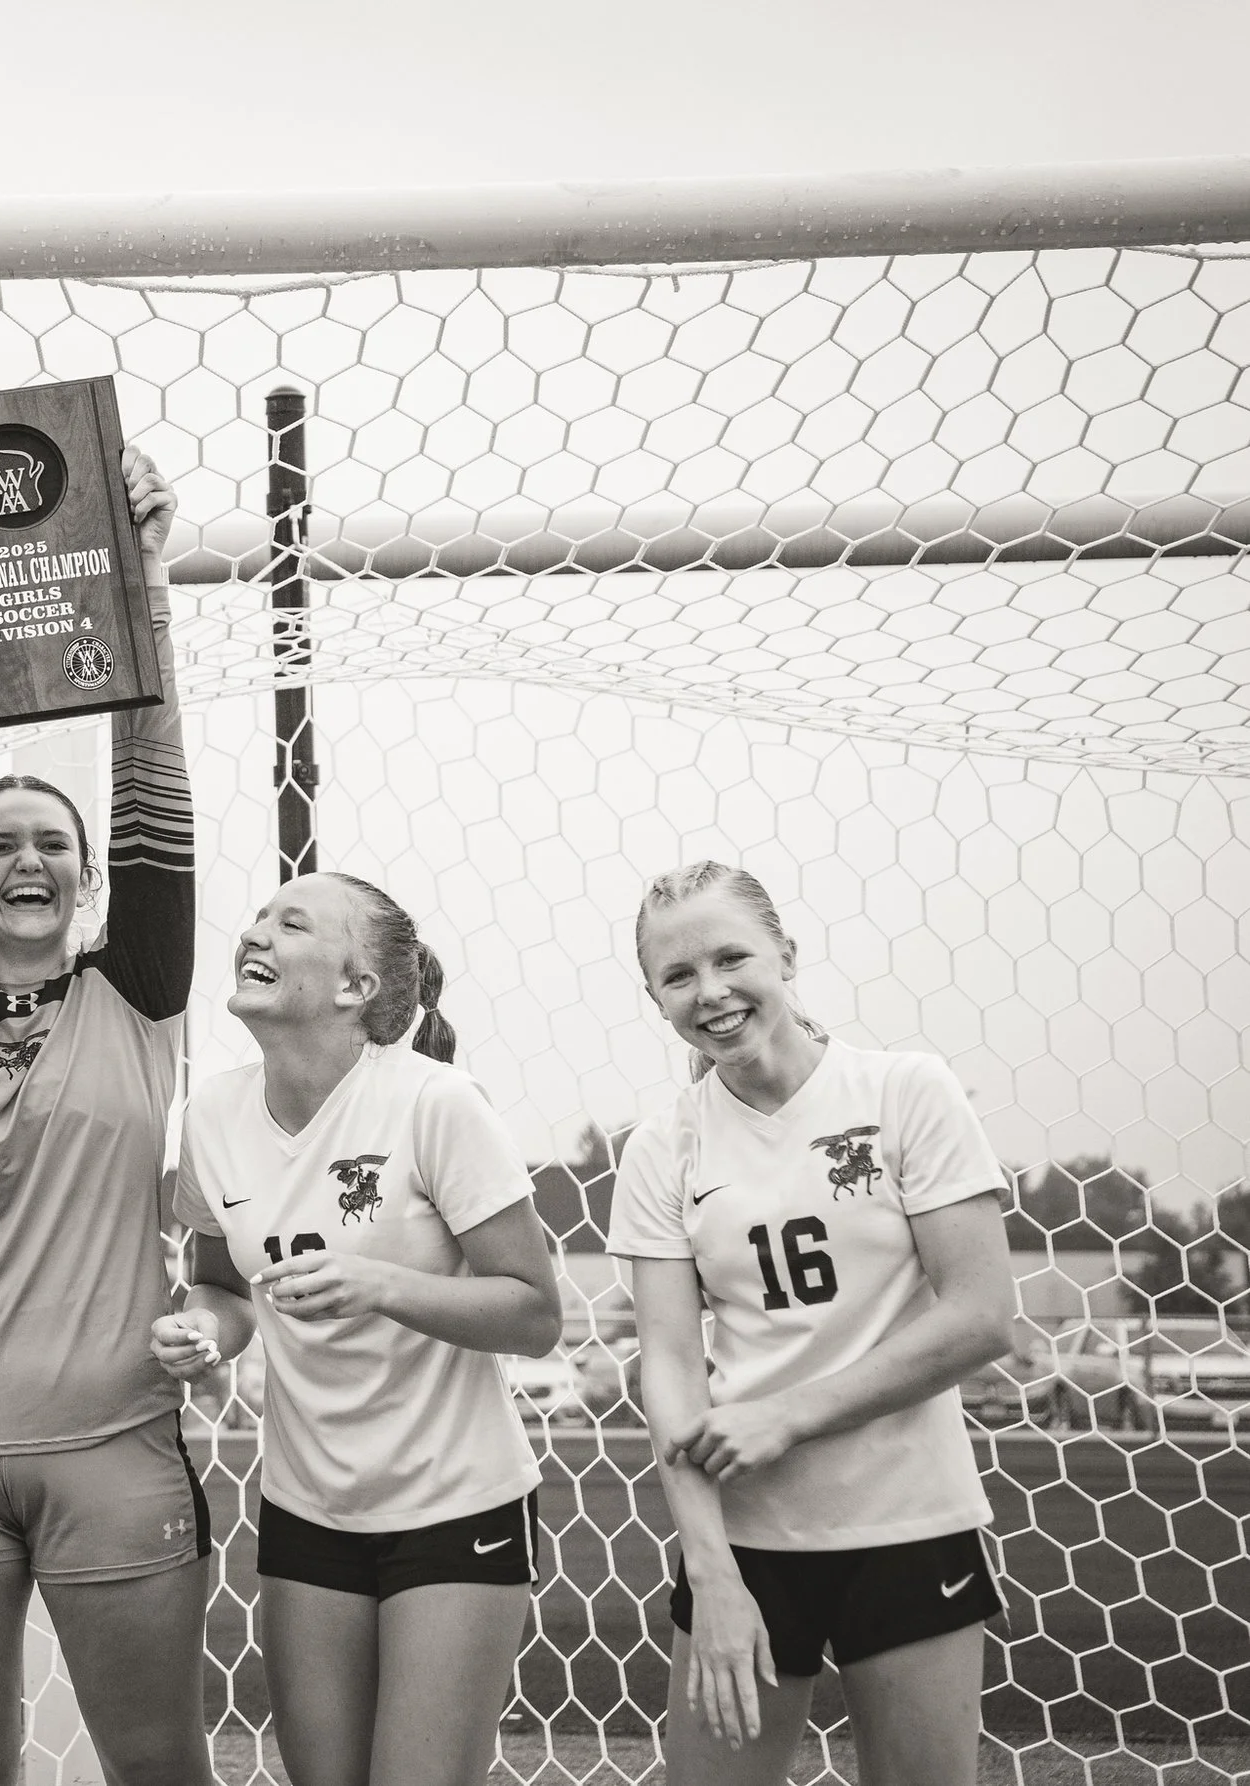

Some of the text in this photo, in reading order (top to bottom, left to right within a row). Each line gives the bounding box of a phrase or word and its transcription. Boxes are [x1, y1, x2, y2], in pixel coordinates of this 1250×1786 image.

[29, 547, 111, 584] CHAMPION
[80, 616, 93, 630] 4
[748, 1215, 839, 1311] 16
